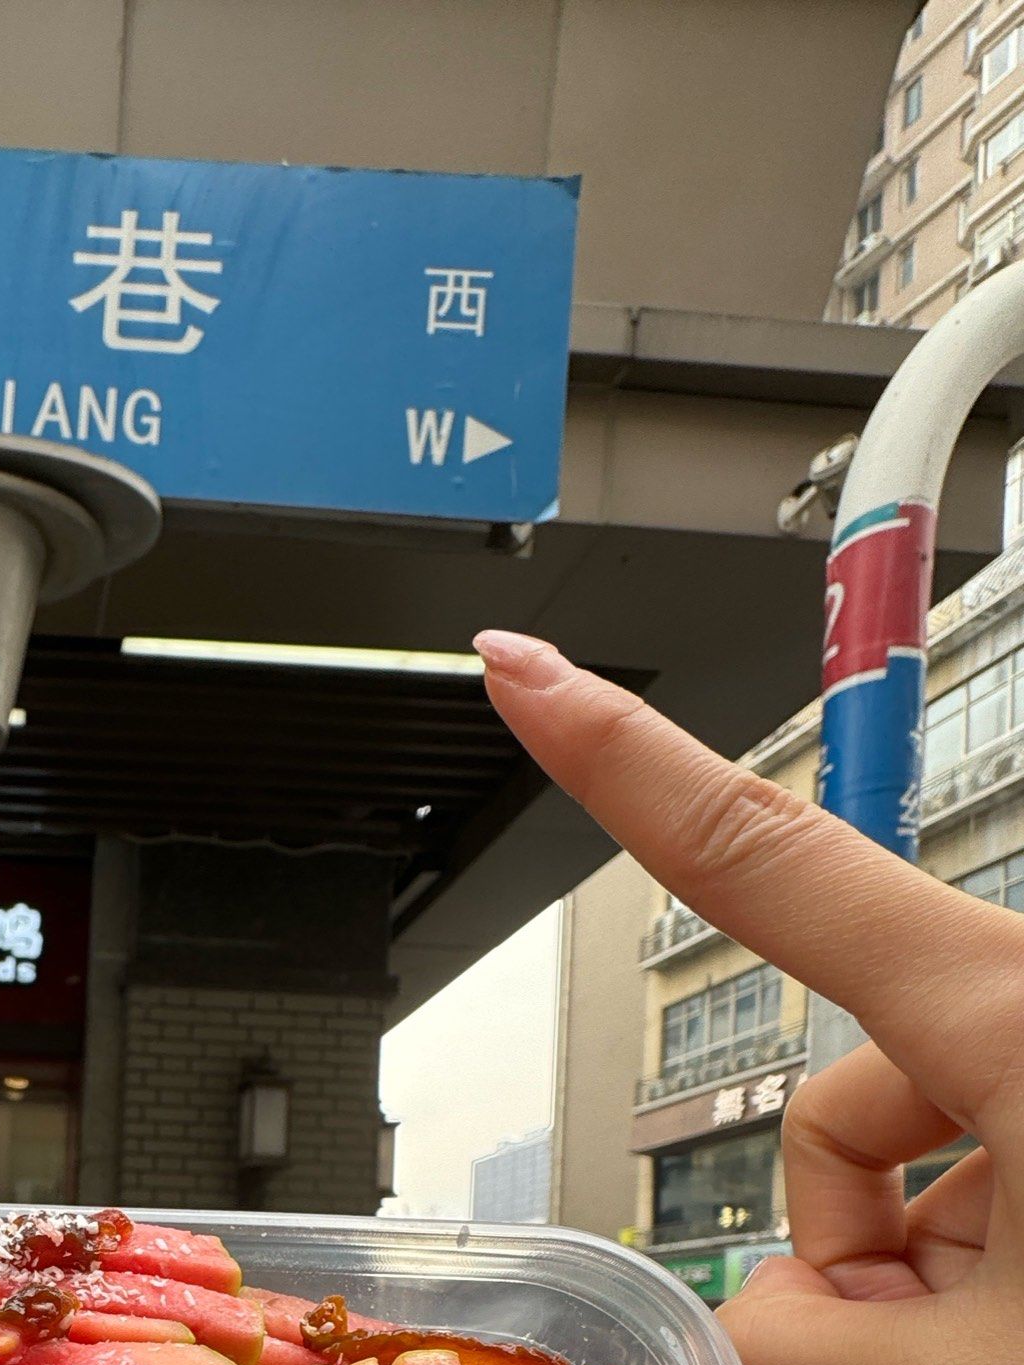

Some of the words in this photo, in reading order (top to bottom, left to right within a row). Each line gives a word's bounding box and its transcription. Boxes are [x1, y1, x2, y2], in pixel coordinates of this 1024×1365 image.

[424, 267, 495, 338] 西
[405, 407, 455, 466] W
[712, 1073, 808, 1126] 無名
